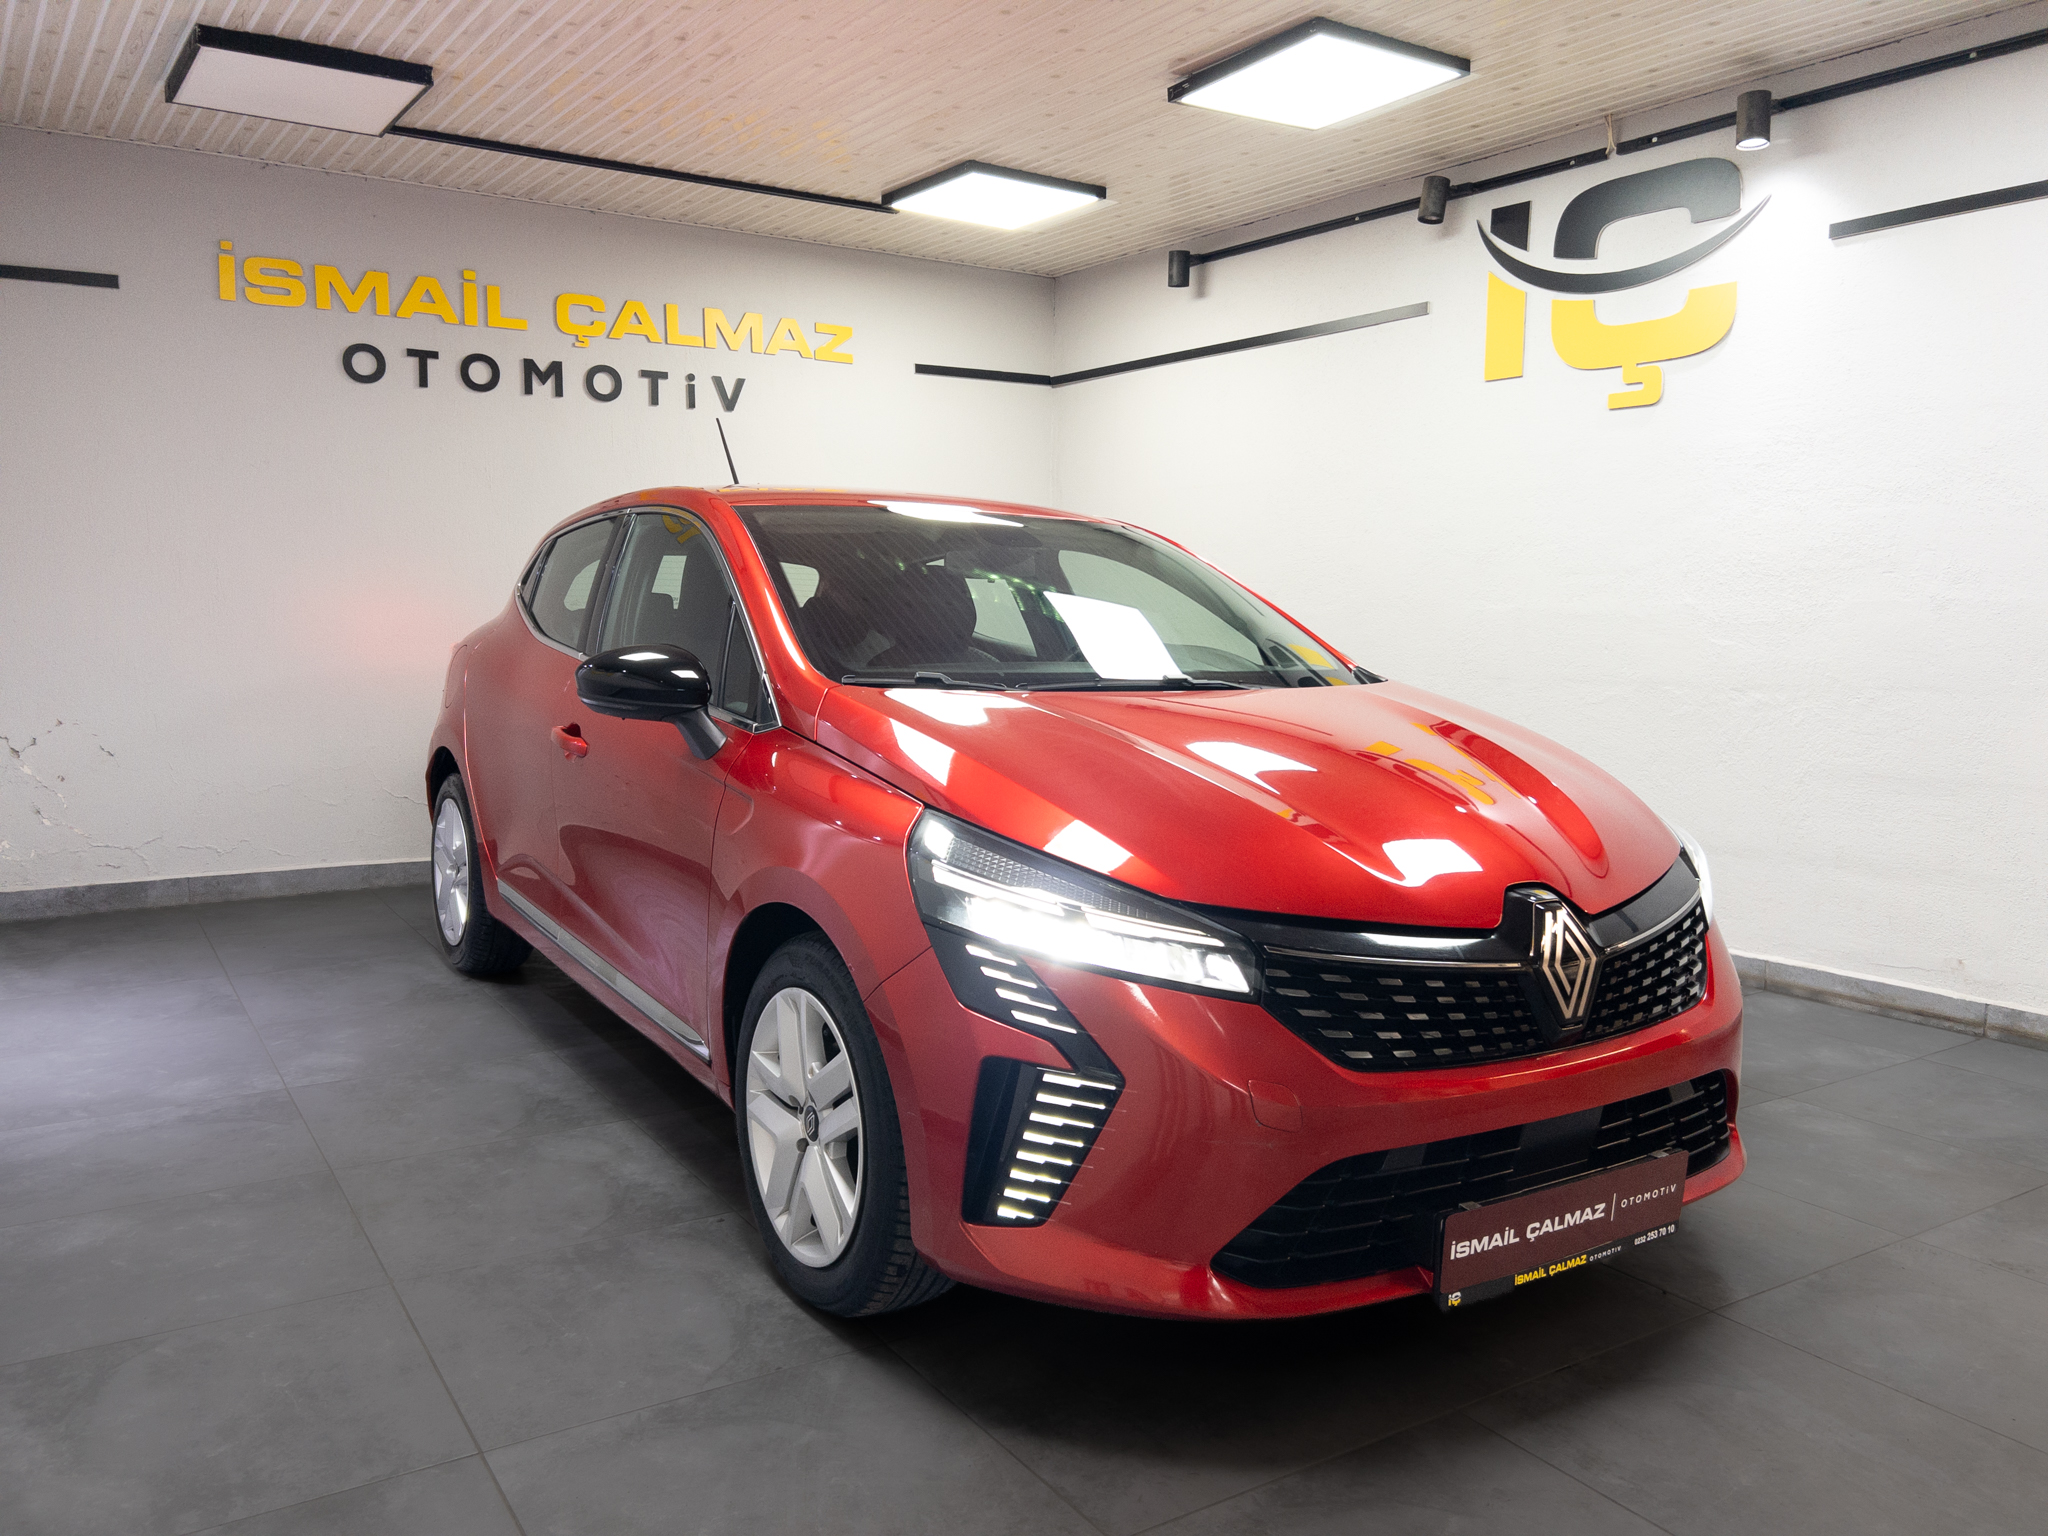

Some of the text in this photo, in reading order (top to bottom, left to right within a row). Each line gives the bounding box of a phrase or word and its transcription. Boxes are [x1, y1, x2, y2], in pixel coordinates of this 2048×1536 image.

[218, 241, 854, 364] İSMAİL ÇALMAZ
[1450, 1227, 1520, 1260] İSMAİL
[1526, 1203, 1606, 1242] ÇALMAZ
[1646, 1230, 1659, 1241] 253
[1659, 1227, 1667, 1237] 70
[1667, 1224, 1675, 1233] 10
[1514, 1267, 1547, 1286] İSMAİL
[1549, 1254, 1587, 1276] ÇALMAZ
